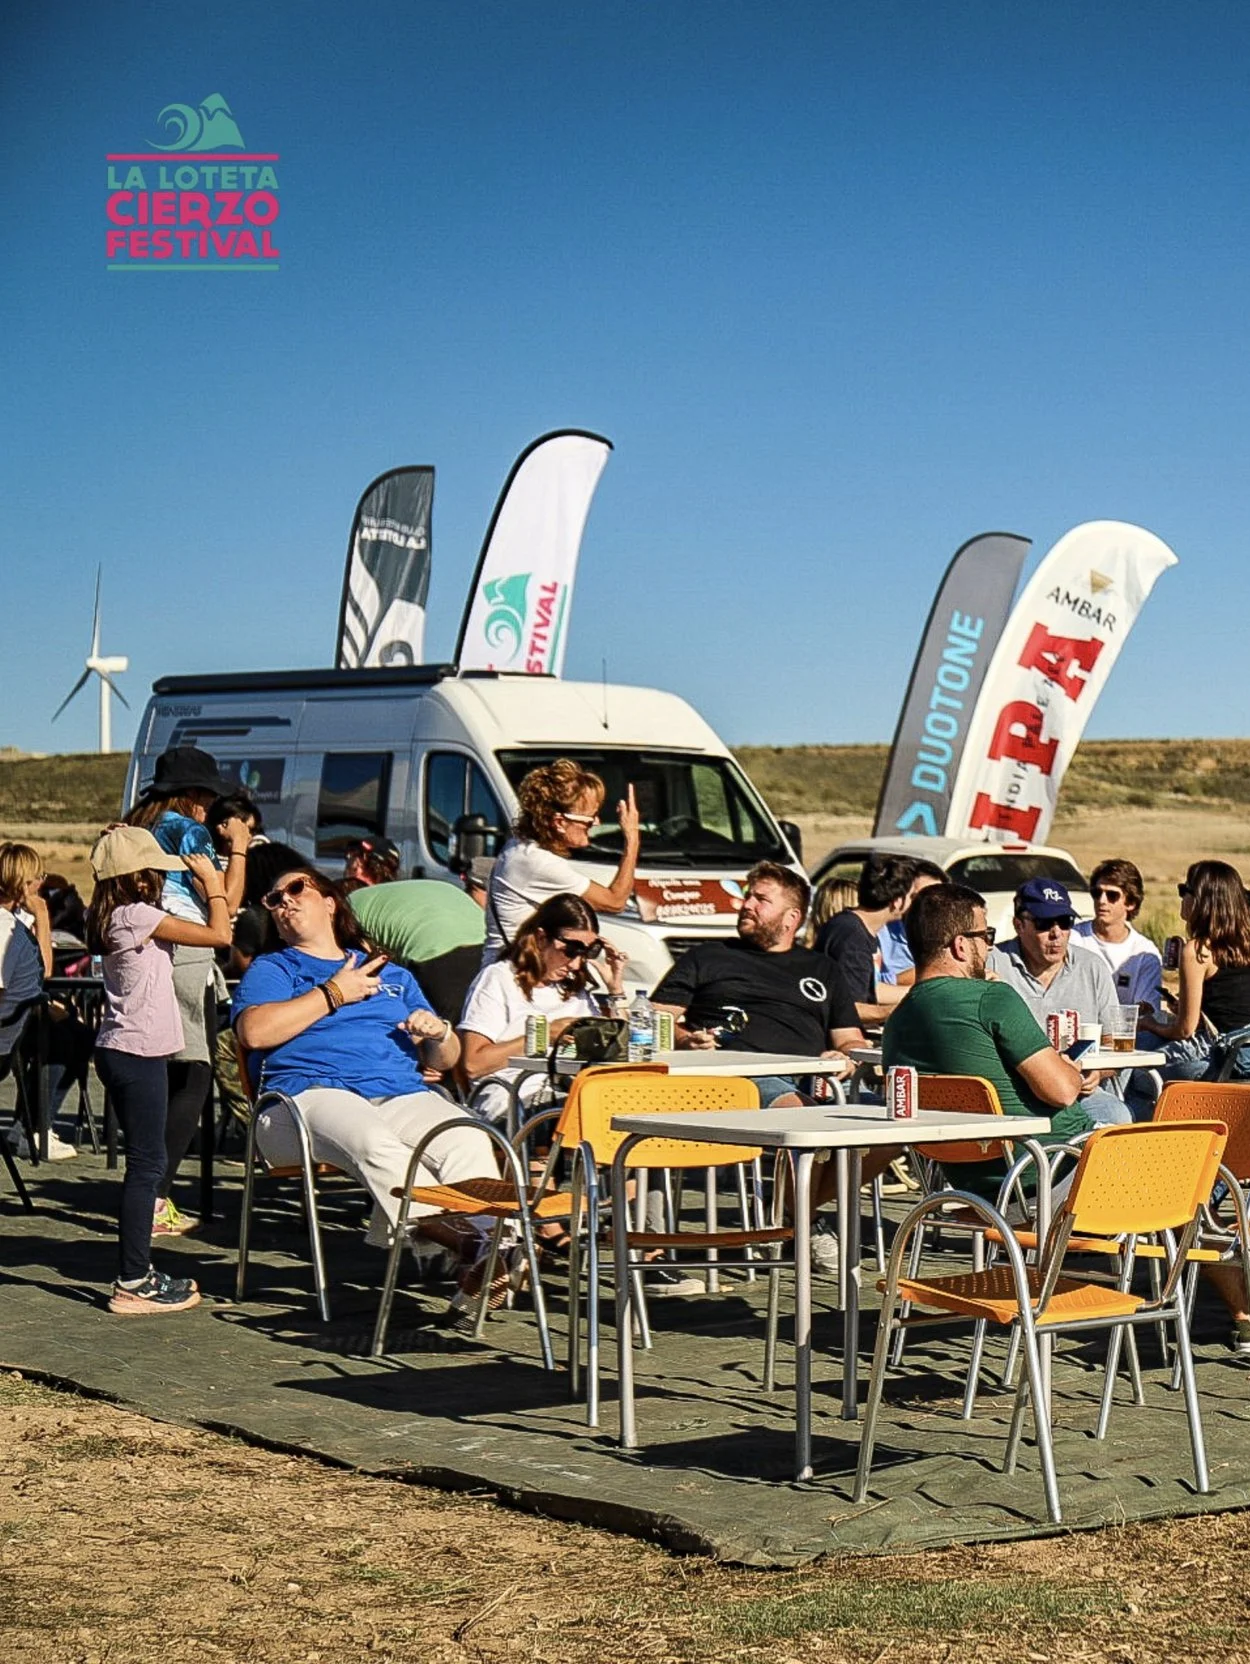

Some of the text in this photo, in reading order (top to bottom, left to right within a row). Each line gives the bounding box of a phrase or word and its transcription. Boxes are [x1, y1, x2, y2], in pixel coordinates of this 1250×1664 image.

[1046, 586, 1118, 633] AMBAR
[911, 611, 984, 793] DUOTONE
[968, 621, 1105, 843] IPA
[896, 1073, 908, 1117] AMBAR
